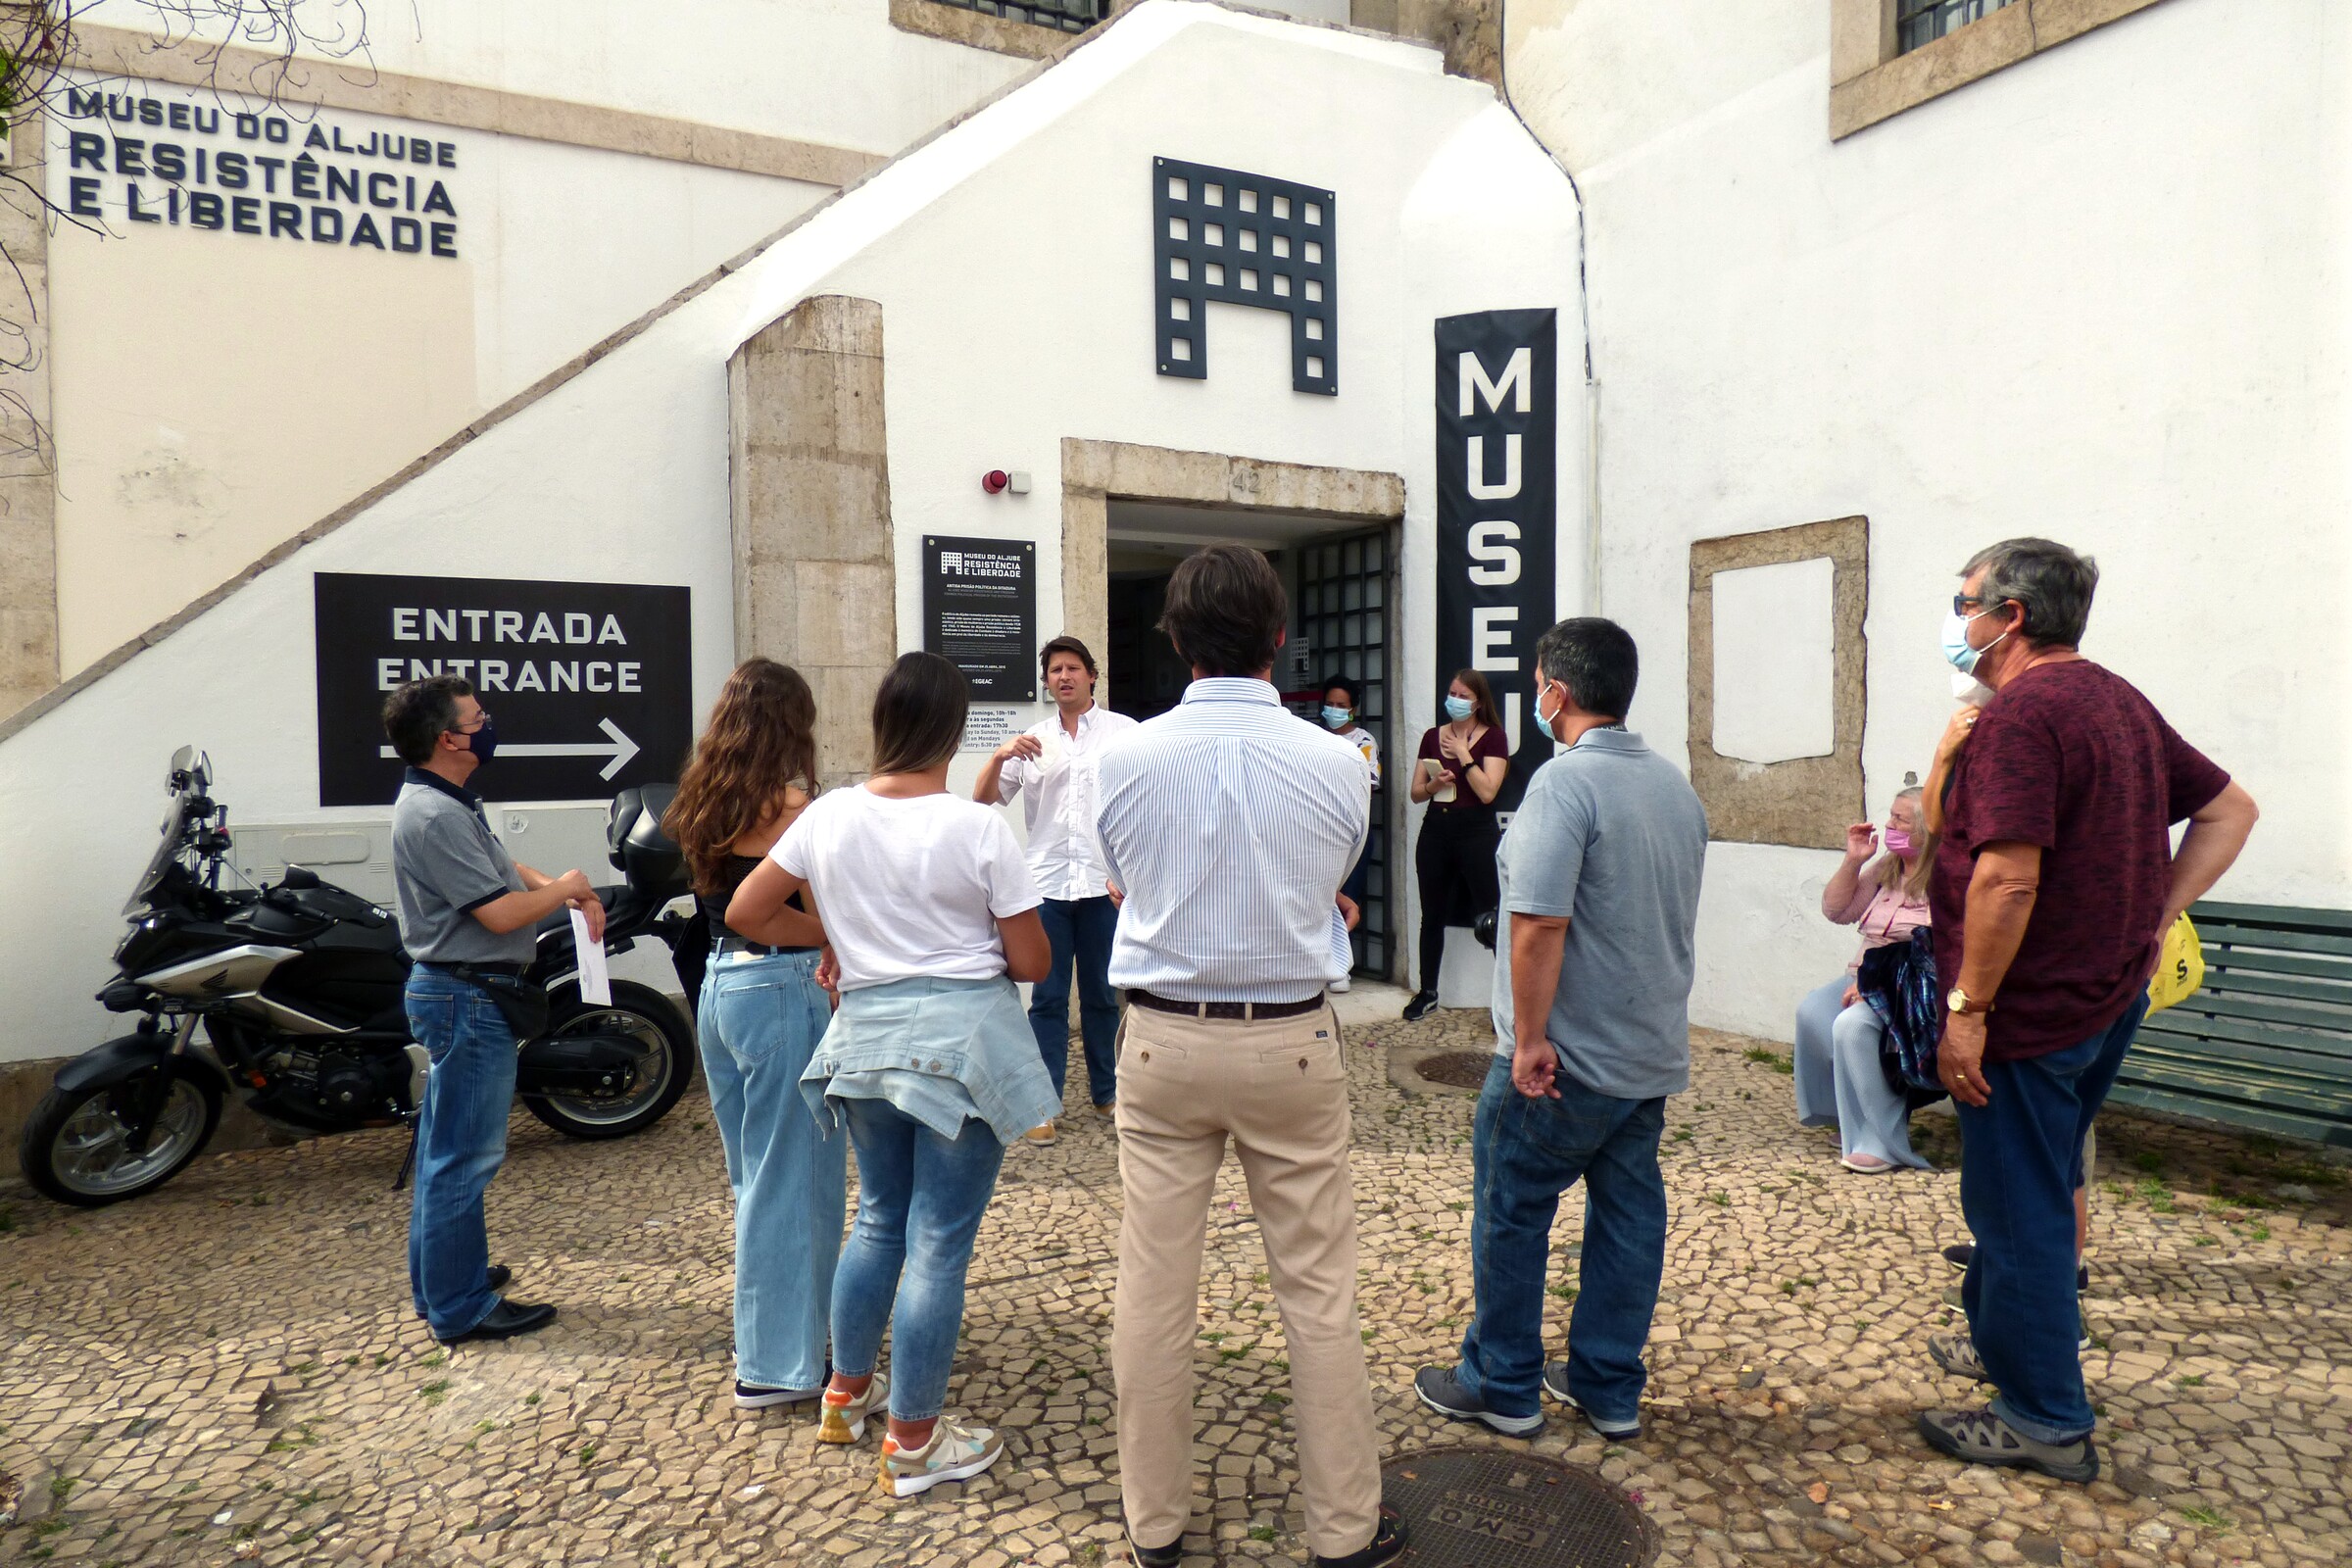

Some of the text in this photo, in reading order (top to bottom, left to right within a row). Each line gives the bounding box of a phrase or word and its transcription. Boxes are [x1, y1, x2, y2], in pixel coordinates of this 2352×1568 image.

[69, 87, 457, 168] MUSEU DO ALJUBE
[70, 131, 457, 217] RESISTÊNCIA
[70, 175, 457, 258] E LIBERDADE
[1233, 468, 1260, 493] 42
[964, 560, 1021, 569] RESISTÊNCIA
[972, 568, 1021, 578] LIBERDADE
[392, 607, 627, 645] ENTRADA
[377, 658, 642, 693] ENTRANCE
